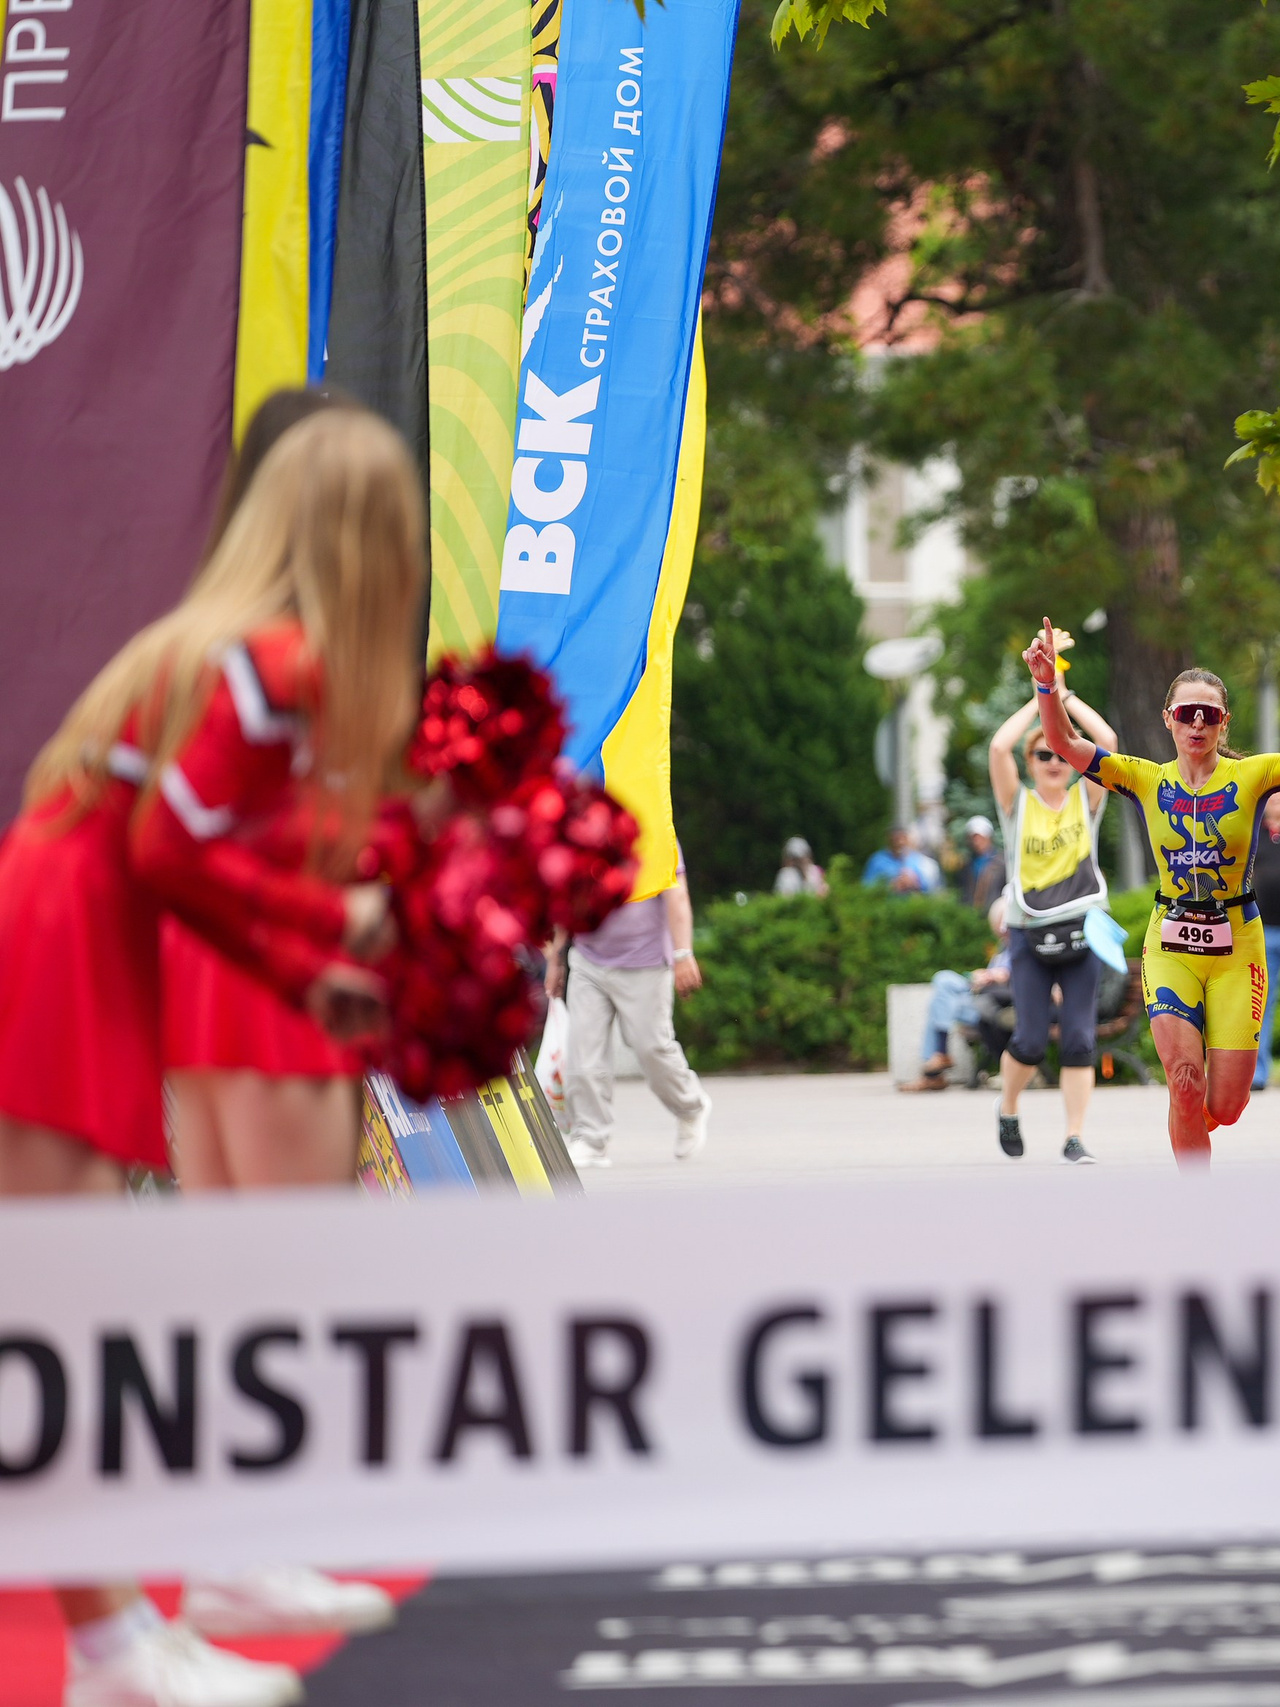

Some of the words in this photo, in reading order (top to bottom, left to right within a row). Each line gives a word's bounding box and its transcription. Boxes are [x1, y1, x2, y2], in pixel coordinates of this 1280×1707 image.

[579, 147, 635, 368] СТРАХОВОЙ
[612, 46, 645, 136] ДОМ
[1169, 850, 1221, 866] HOKA
[1178, 926, 1214, 944] 496
[0, 1313, 655, 1490] ONSTAR
